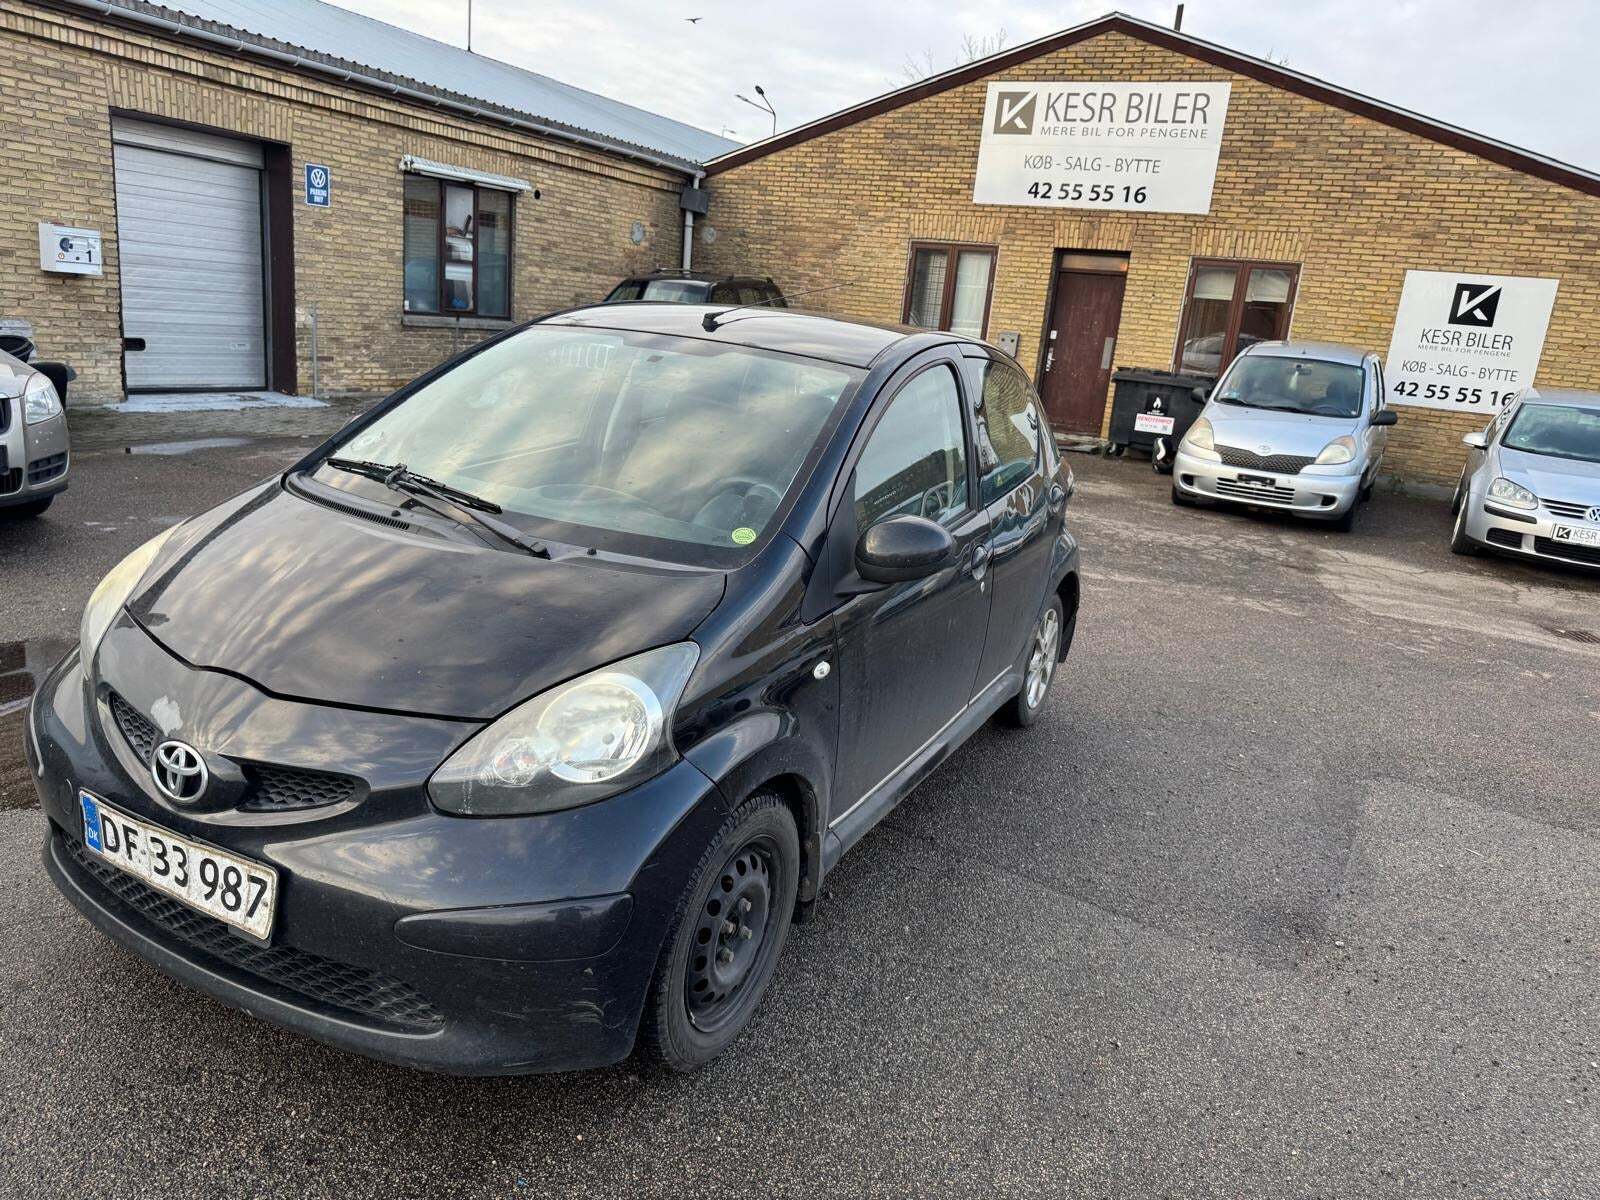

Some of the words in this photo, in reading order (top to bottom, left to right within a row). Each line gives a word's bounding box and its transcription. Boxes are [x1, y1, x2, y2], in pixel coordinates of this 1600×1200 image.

[1043, 92, 1117, 124] KESR
[1125, 92, 1211, 125] BILER
[1041, 126, 1076, 137] MERE
[1082, 126, 1101, 137] BIL
[1107, 127, 1134, 138] FOR
[1140, 127, 1209, 139] PENGENE
[1024, 154, 1052, 170] KØB
[1064, 156, 1102, 172] SALG
[1114, 158, 1161, 174] BYTTE
[1027, 182, 1053, 200] 42
[1057, 184, 1083, 201] 55
[1088, 185, 1114, 202] 55
[1122, 186, 1147, 204] 16
[1420, 328, 1462, 346] KESR
[1466, 332, 1513, 351] BILER
[1474, 349, 1511, 358] PENGENE
[1402, 360, 1426, 374] KØB
[1436, 363, 1468, 378] SALG
[1478, 367, 1519, 383] BYTTE
[1394, 381, 1419, 397] 42
[1424, 384, 1450, 400] 55
[1455, 387, 1482, 404] 55
[1573, 529, 1597, 539] KESR
[89, 827, 98, 843] DK
[100, 813, 138, 861] DF
[150, 836, 189, 887] 33
[199, 857, 268, 918] 987
